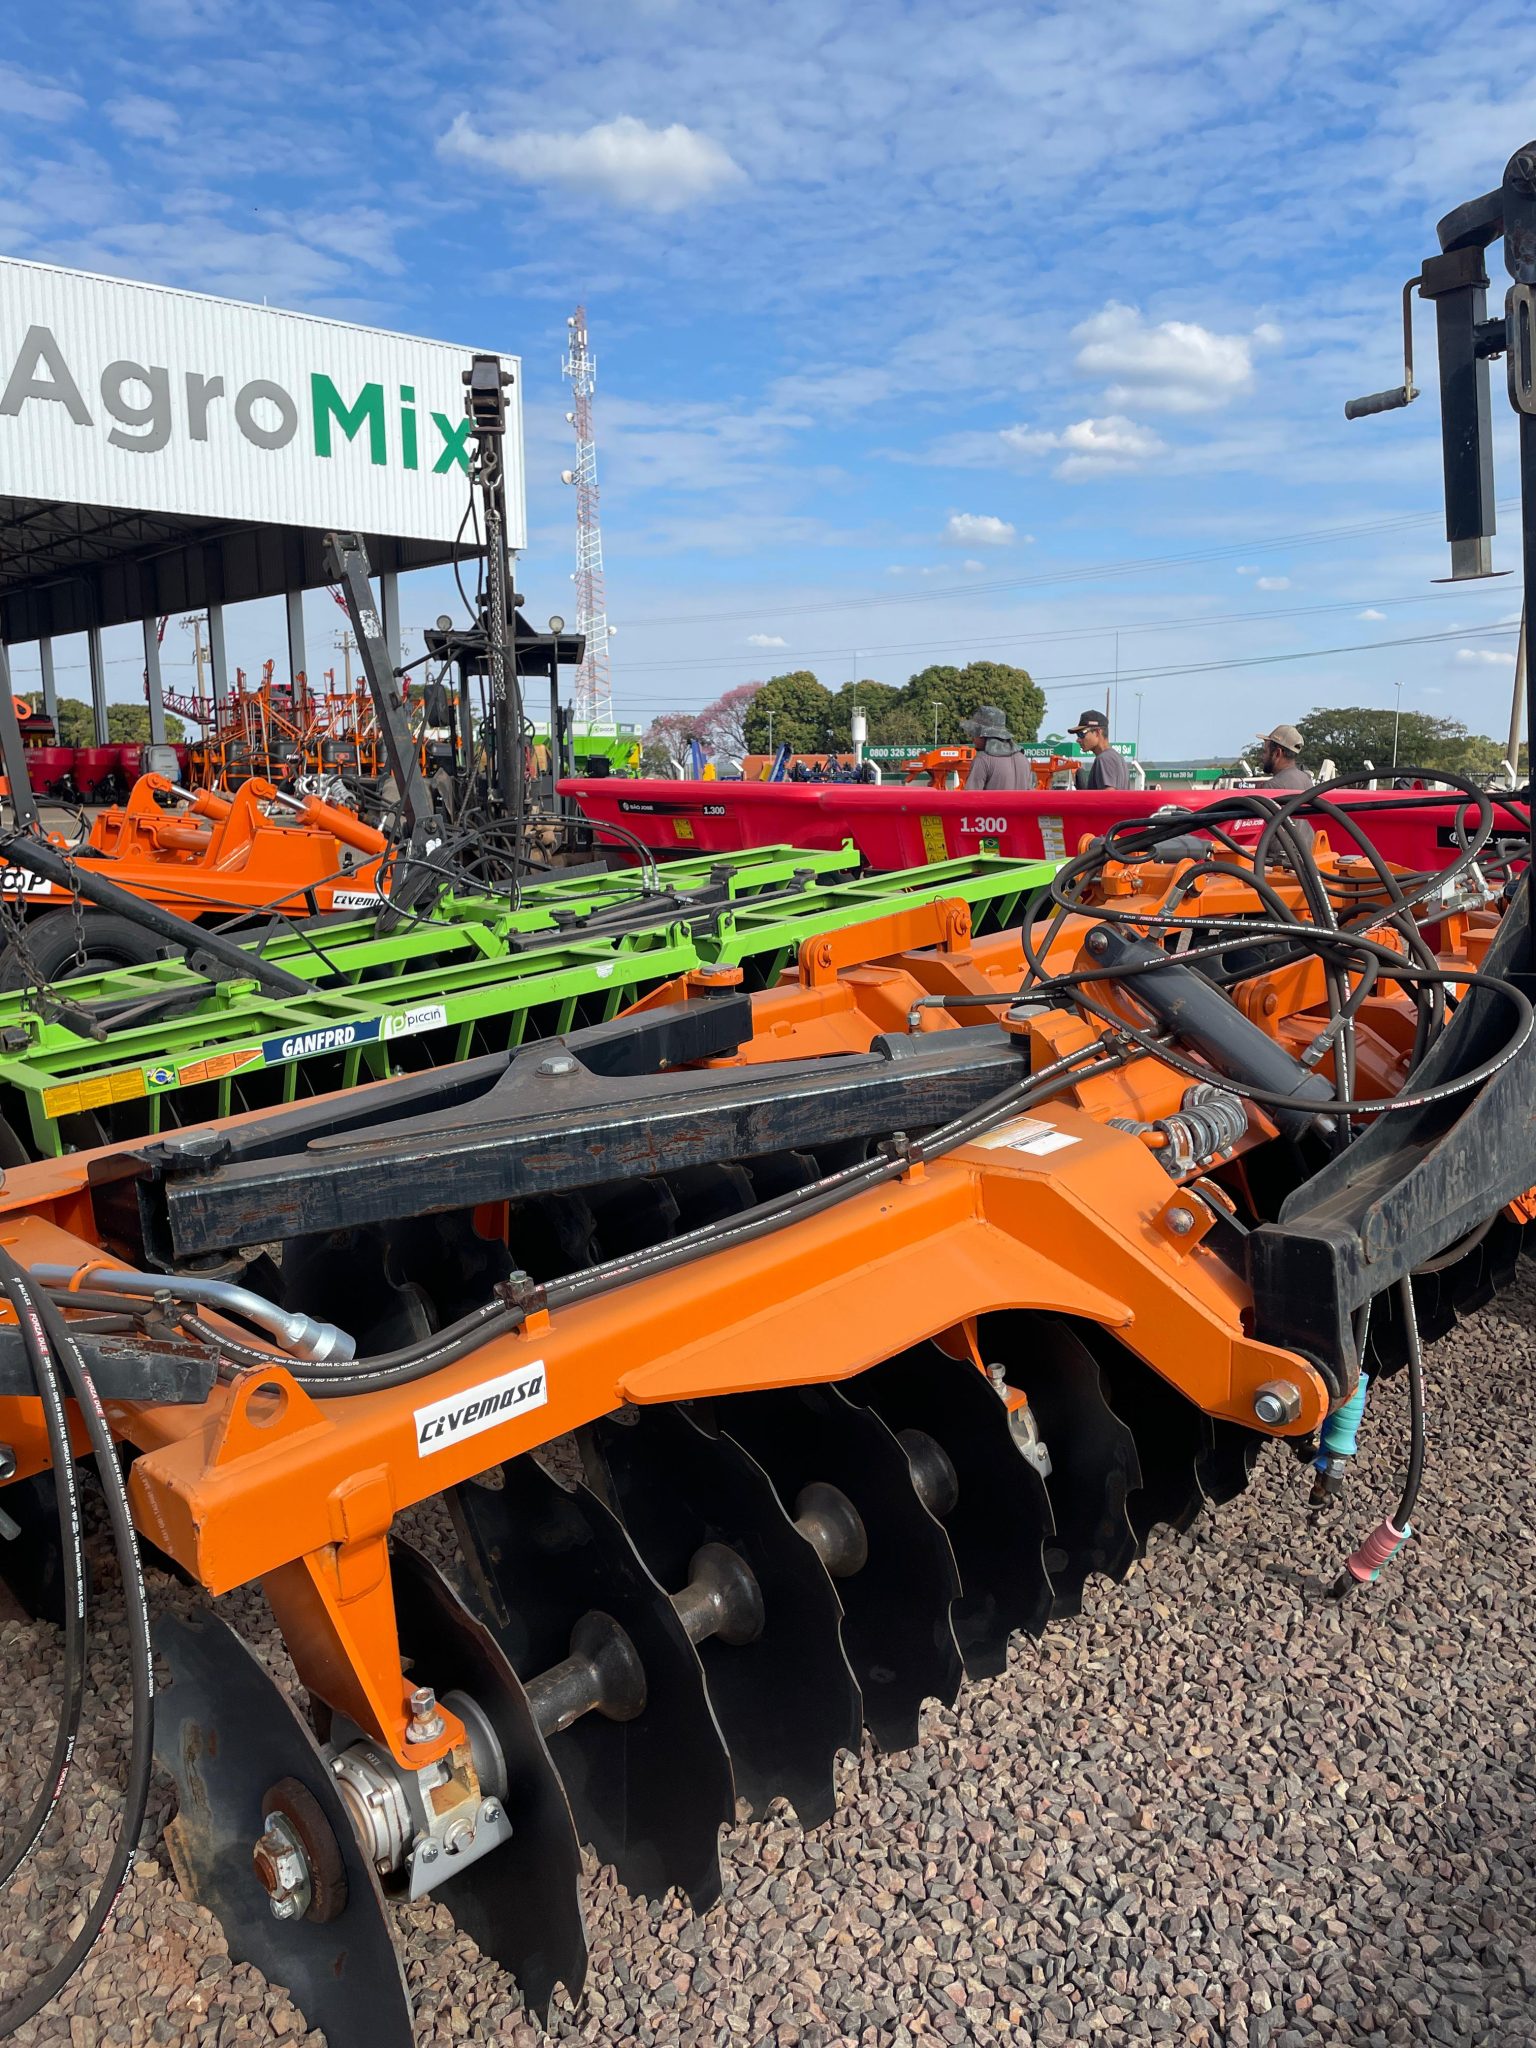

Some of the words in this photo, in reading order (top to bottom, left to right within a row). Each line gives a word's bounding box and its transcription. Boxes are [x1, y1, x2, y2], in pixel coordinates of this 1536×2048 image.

[869, 748, 889, 757] 0800
[890, 748, 905, 757] 326
[907, 748, 927, 757] 366
[1122, 745, 1132, 754] Sul
[703, 806, 725, 815] 1.300
[960, 817, 1007, 833] 1.300
[407, 1008, 441, 1027] piccin
[282, 1026, 355, 1058] GANFPRD
[1391, 1101, 1409, 1110] FORZA
[1410, 1098, 1421, 1106] DUE
[18, 1283, 32, 1306] BALFLEX
[30, 1313, 42, 1336] FORZA
[38, 1337, 48, 1352] DUE
[287, 1359, 312, 1367] Resistant
[400, 1359, 424, 1369] Resistant
[48, 1372, 57, 1388] DN10
[52, 1391, 60, 1403] DIN
[55, 1403, 62, 1412] EN
[72, 1345, 86, 1368] BALFLEX
[84, 1376, 98, 1400] FORZA
[94, 1400, 104, 1415] DUE
[105, 1434, 114, 1450] DN10
[114, 1464, 121, 1473] EN
[419, 1375, 543, 1444] civemasa
